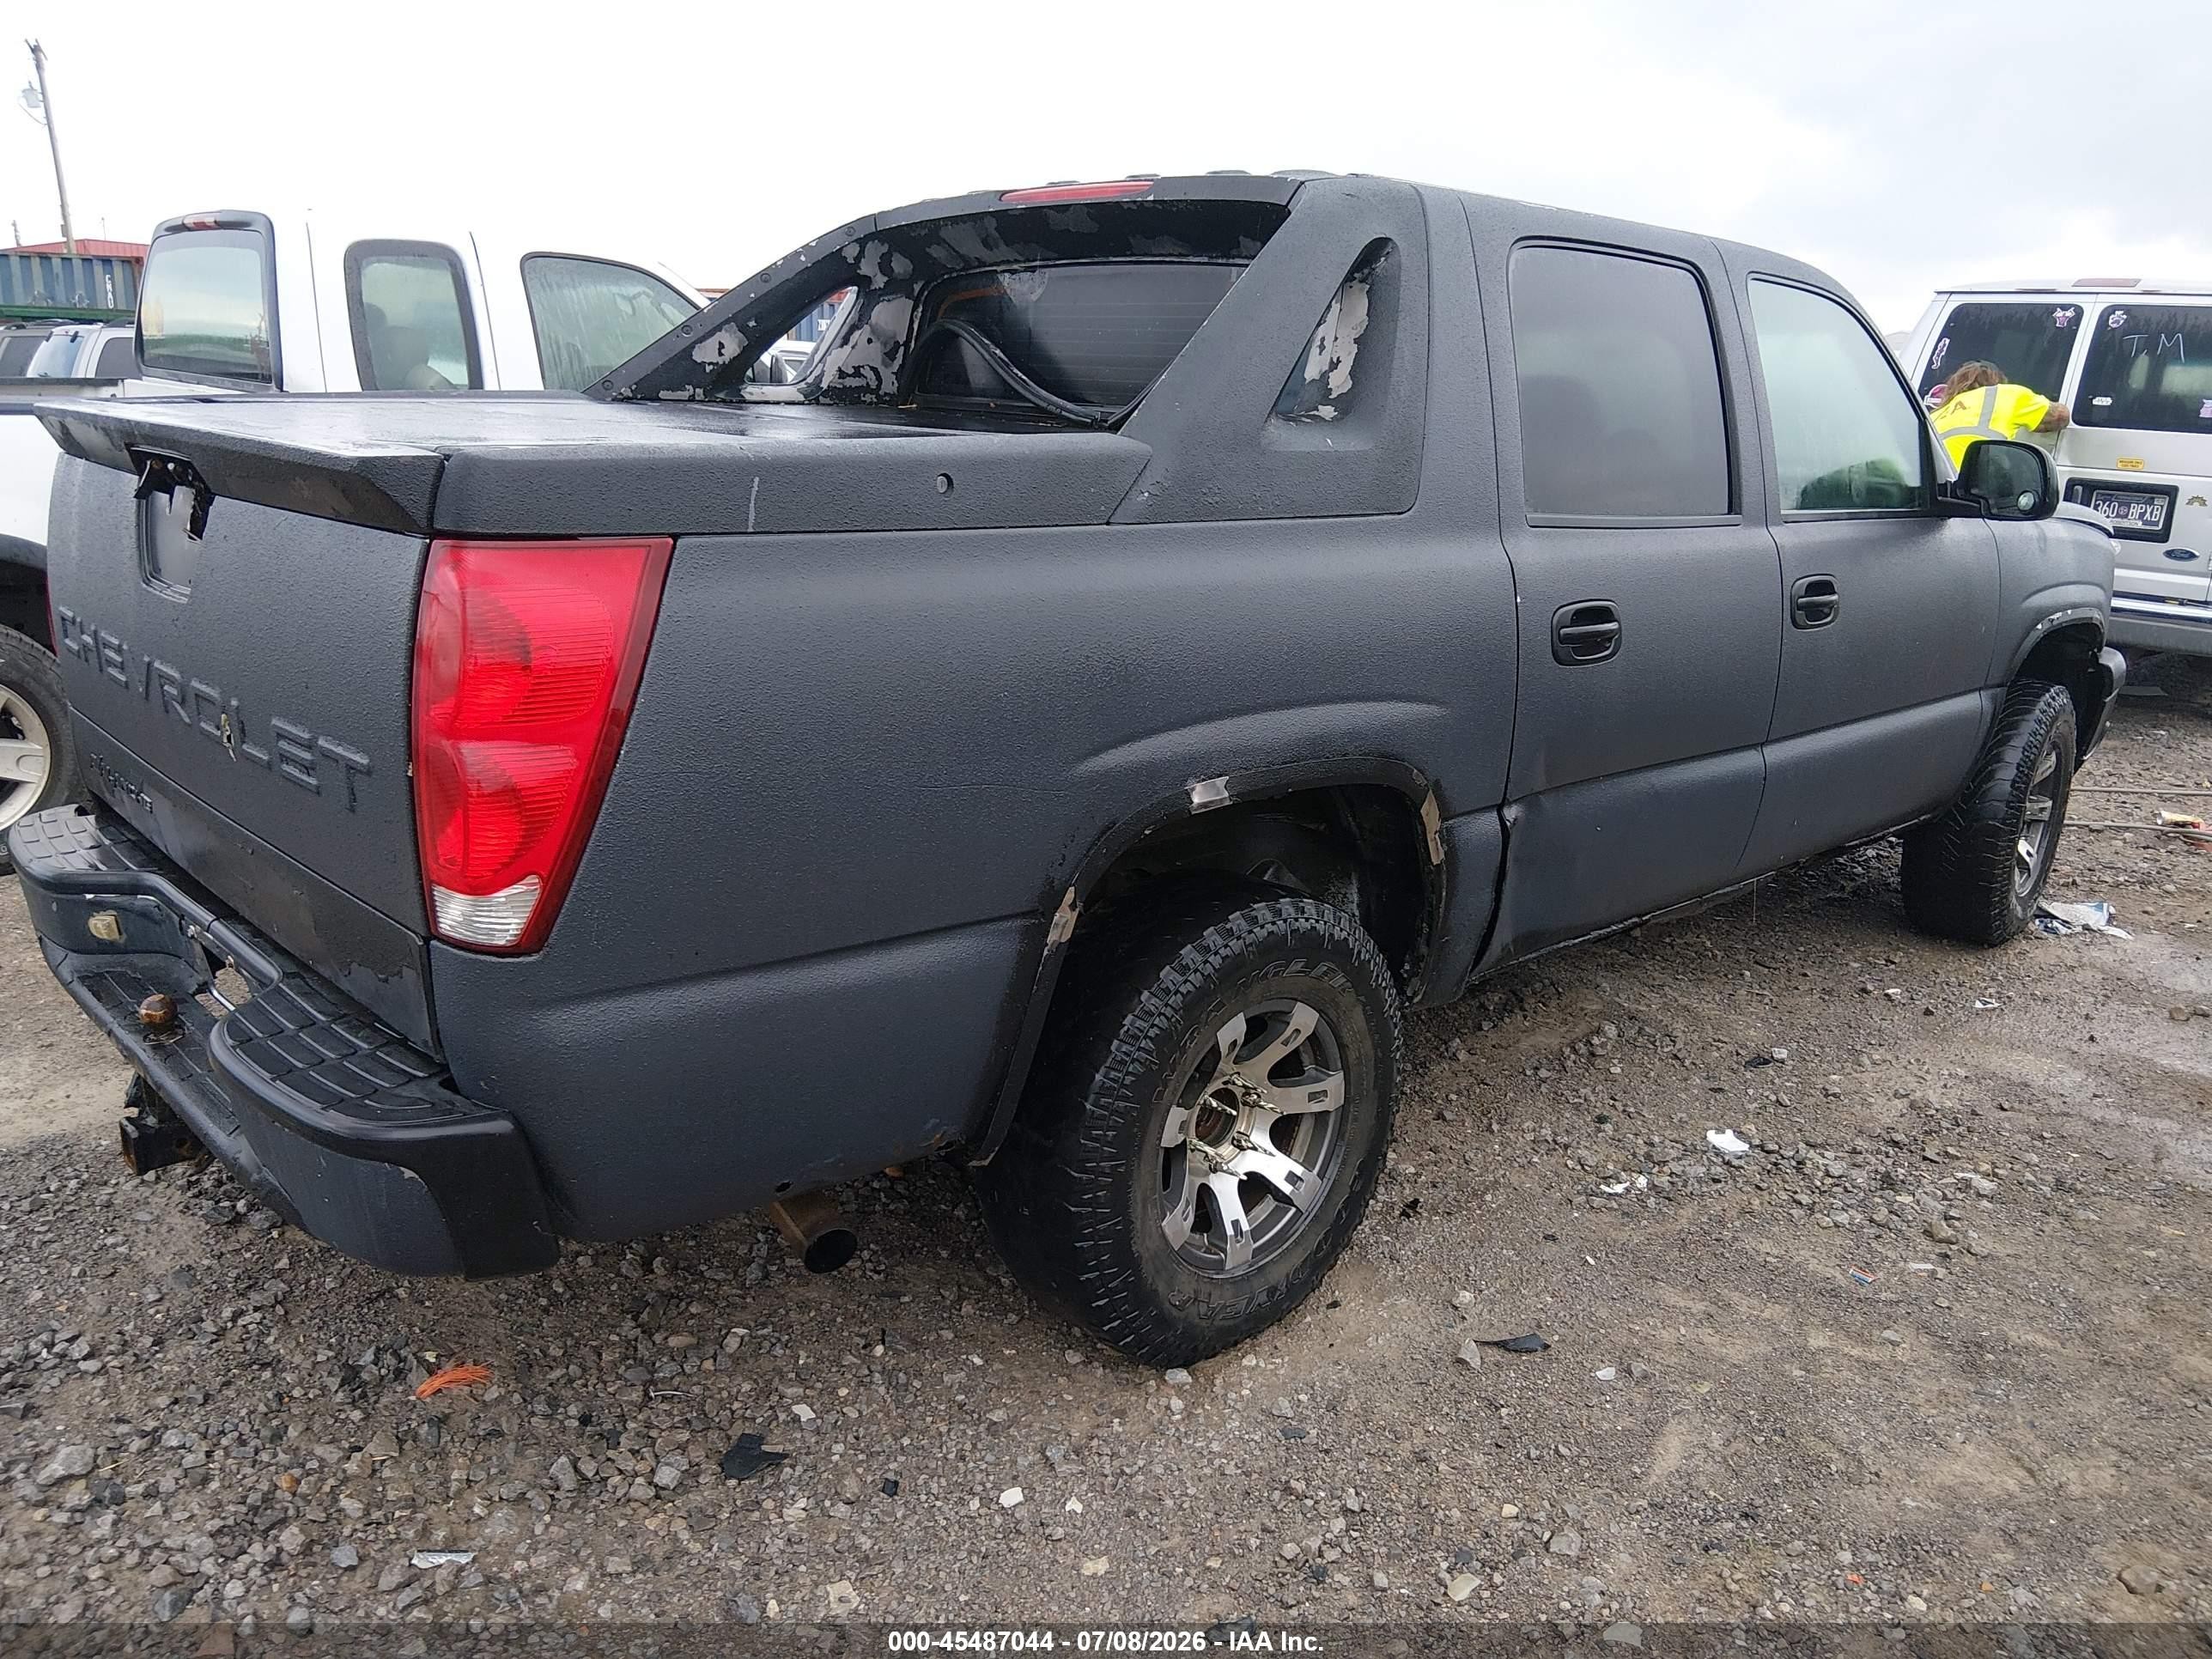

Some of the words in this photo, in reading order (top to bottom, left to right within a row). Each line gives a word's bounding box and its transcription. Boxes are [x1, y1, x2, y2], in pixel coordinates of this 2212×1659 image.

[2095, 500, 2118, 519] 360
[2128, 503, 2162, 522] BPXB
[58, 605, 372, 814] CHEVROLET
